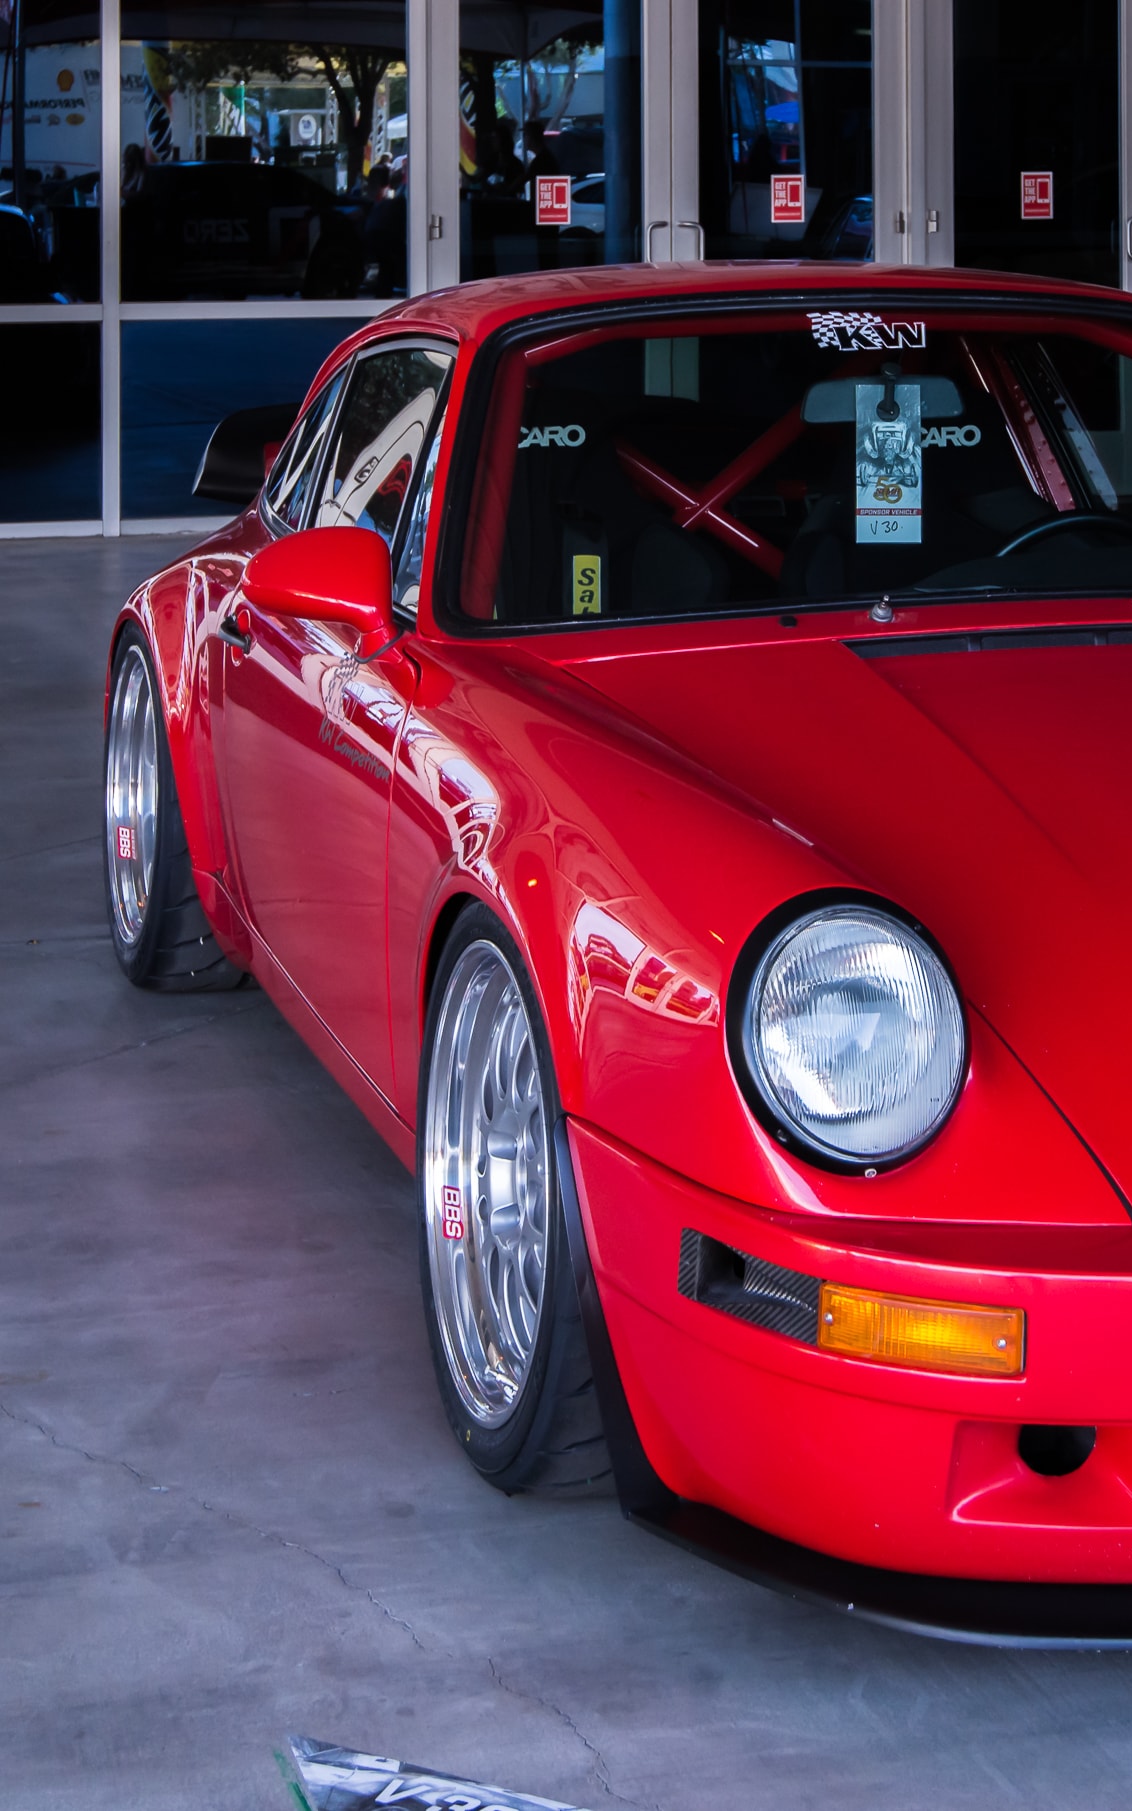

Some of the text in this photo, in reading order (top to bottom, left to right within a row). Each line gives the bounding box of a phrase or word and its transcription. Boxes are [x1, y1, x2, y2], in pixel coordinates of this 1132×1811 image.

[775, 181, 786, 190] GET
[1025, 178, 1036, 186] GET
[540, 183, 552, 191] GET
[1025, 187, 1036, 195] THE
[776, 190, 786, 198] THE
[775, 199, 787, 207] APP
[1025, 195, 1036, 203] APP
[540, 200, 552, 208] APP
[832, 321, 926, 351] KW
[860, 508, 918, 516] SPONSOR VEHICLE
[119, 826, 131, 858] BBS
[444, 1188, 462, 1239] BBS
